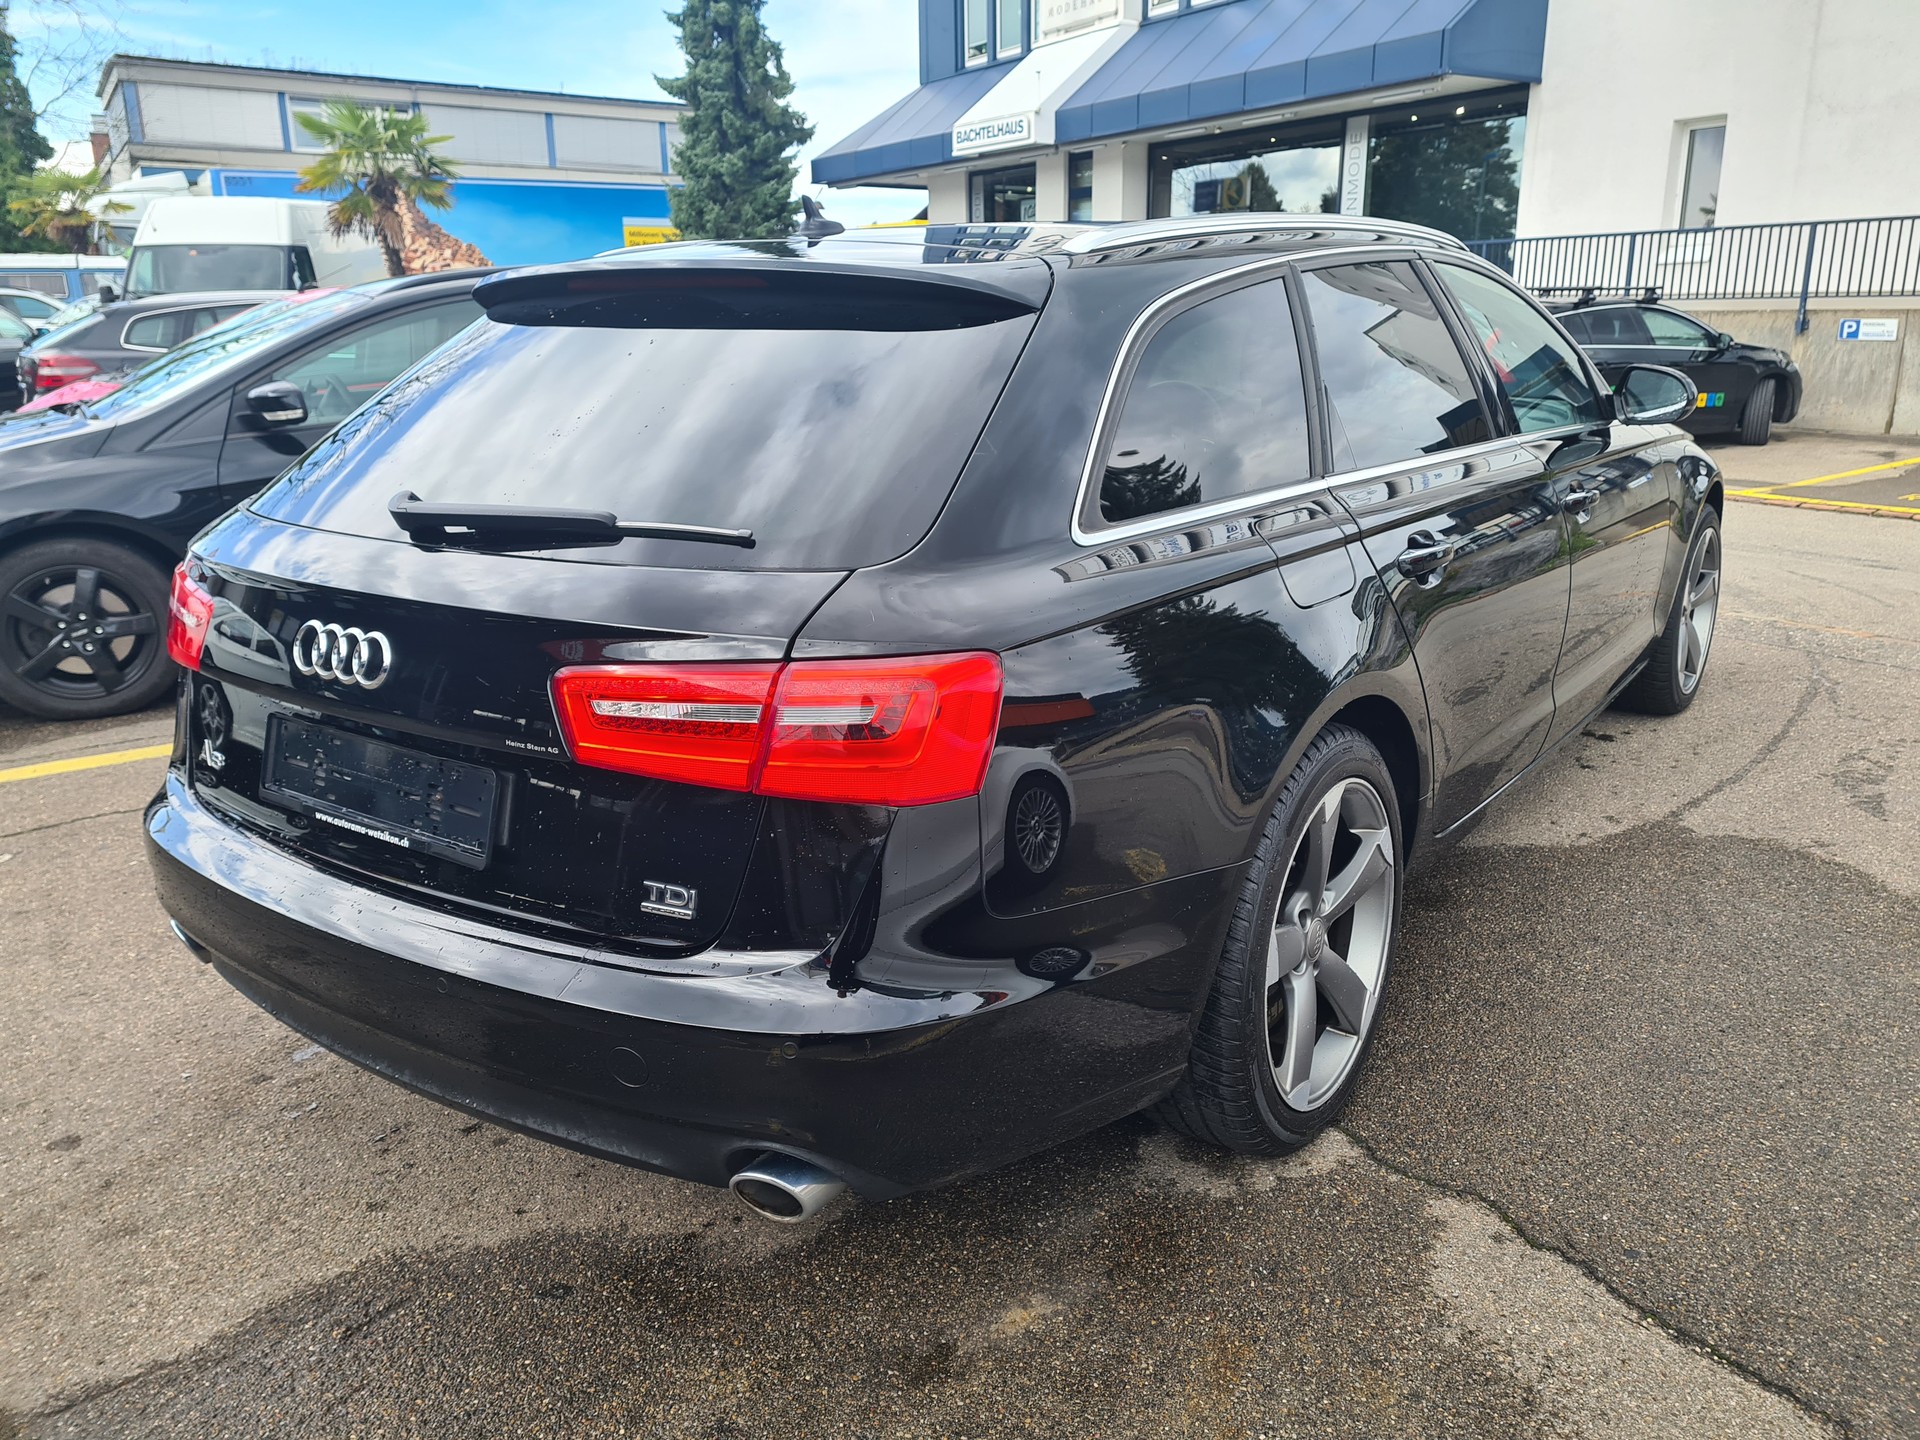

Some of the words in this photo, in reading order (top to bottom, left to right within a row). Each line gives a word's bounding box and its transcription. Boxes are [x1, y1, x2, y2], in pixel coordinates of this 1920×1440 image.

[956, 119, 1024, 144] BACHTELHAUS
[199, 739, 226, 770] A6
[505, 739, 526, 749] Heinz
[526, 742, 546, 752] Stern
[547, 746, 559, 754] AG
[315, 811, 409, 848] www.autorama-wetzikon.ch
[643, 880, 697, 910] TDI
